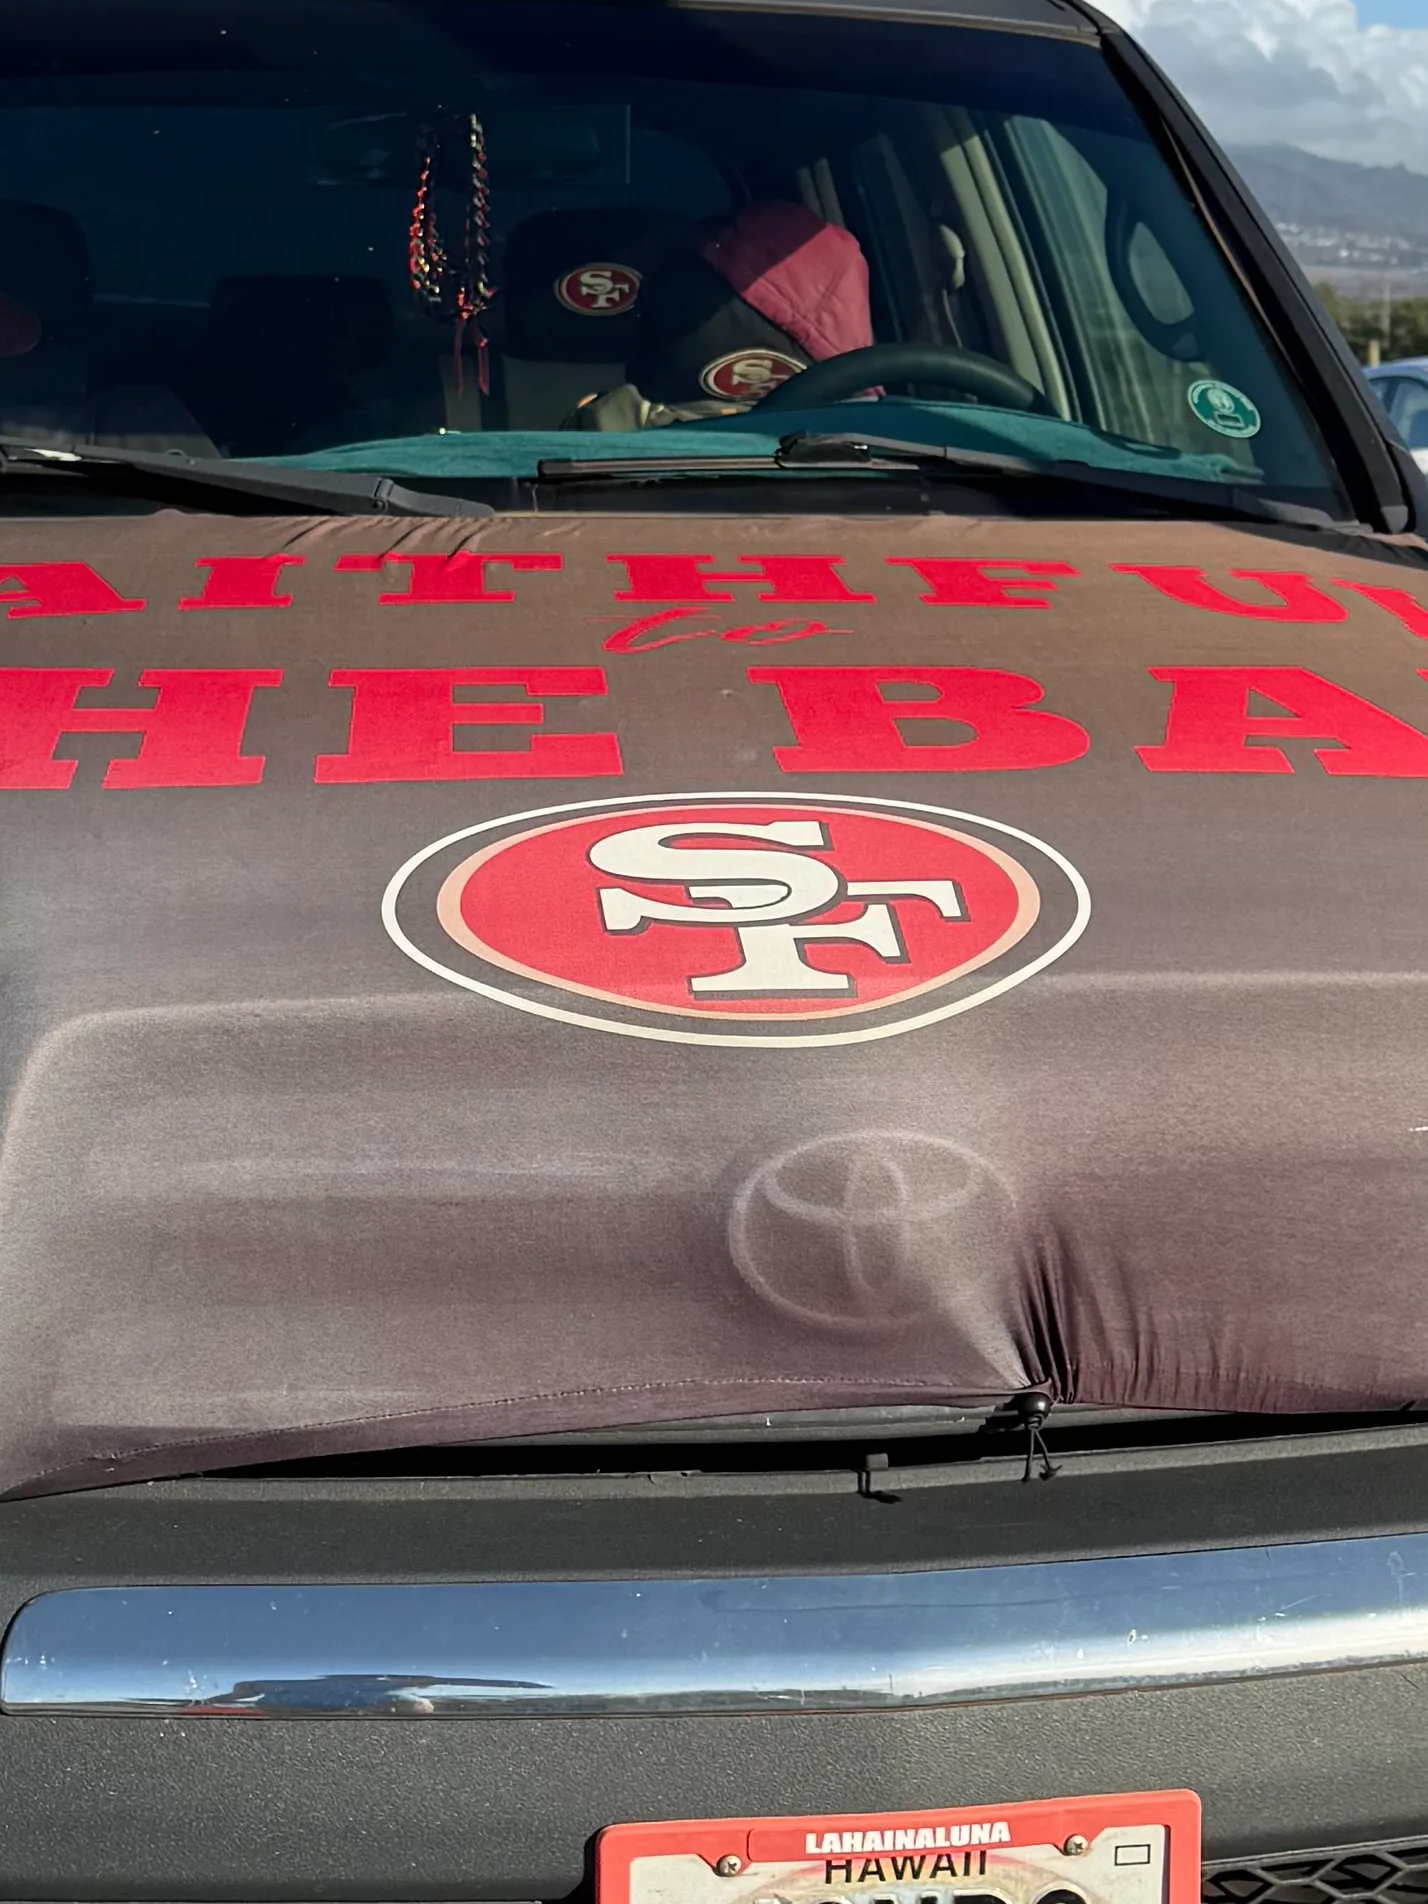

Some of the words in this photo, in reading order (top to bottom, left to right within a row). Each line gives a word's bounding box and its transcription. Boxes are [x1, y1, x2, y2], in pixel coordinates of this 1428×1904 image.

[584, 606, 854, 654] to
[588, 820, 970, 999] SF
[805, 1821, 1011, 1854] LAHAINALUNA
[824, 1850, 988, 1885] HAWAII
